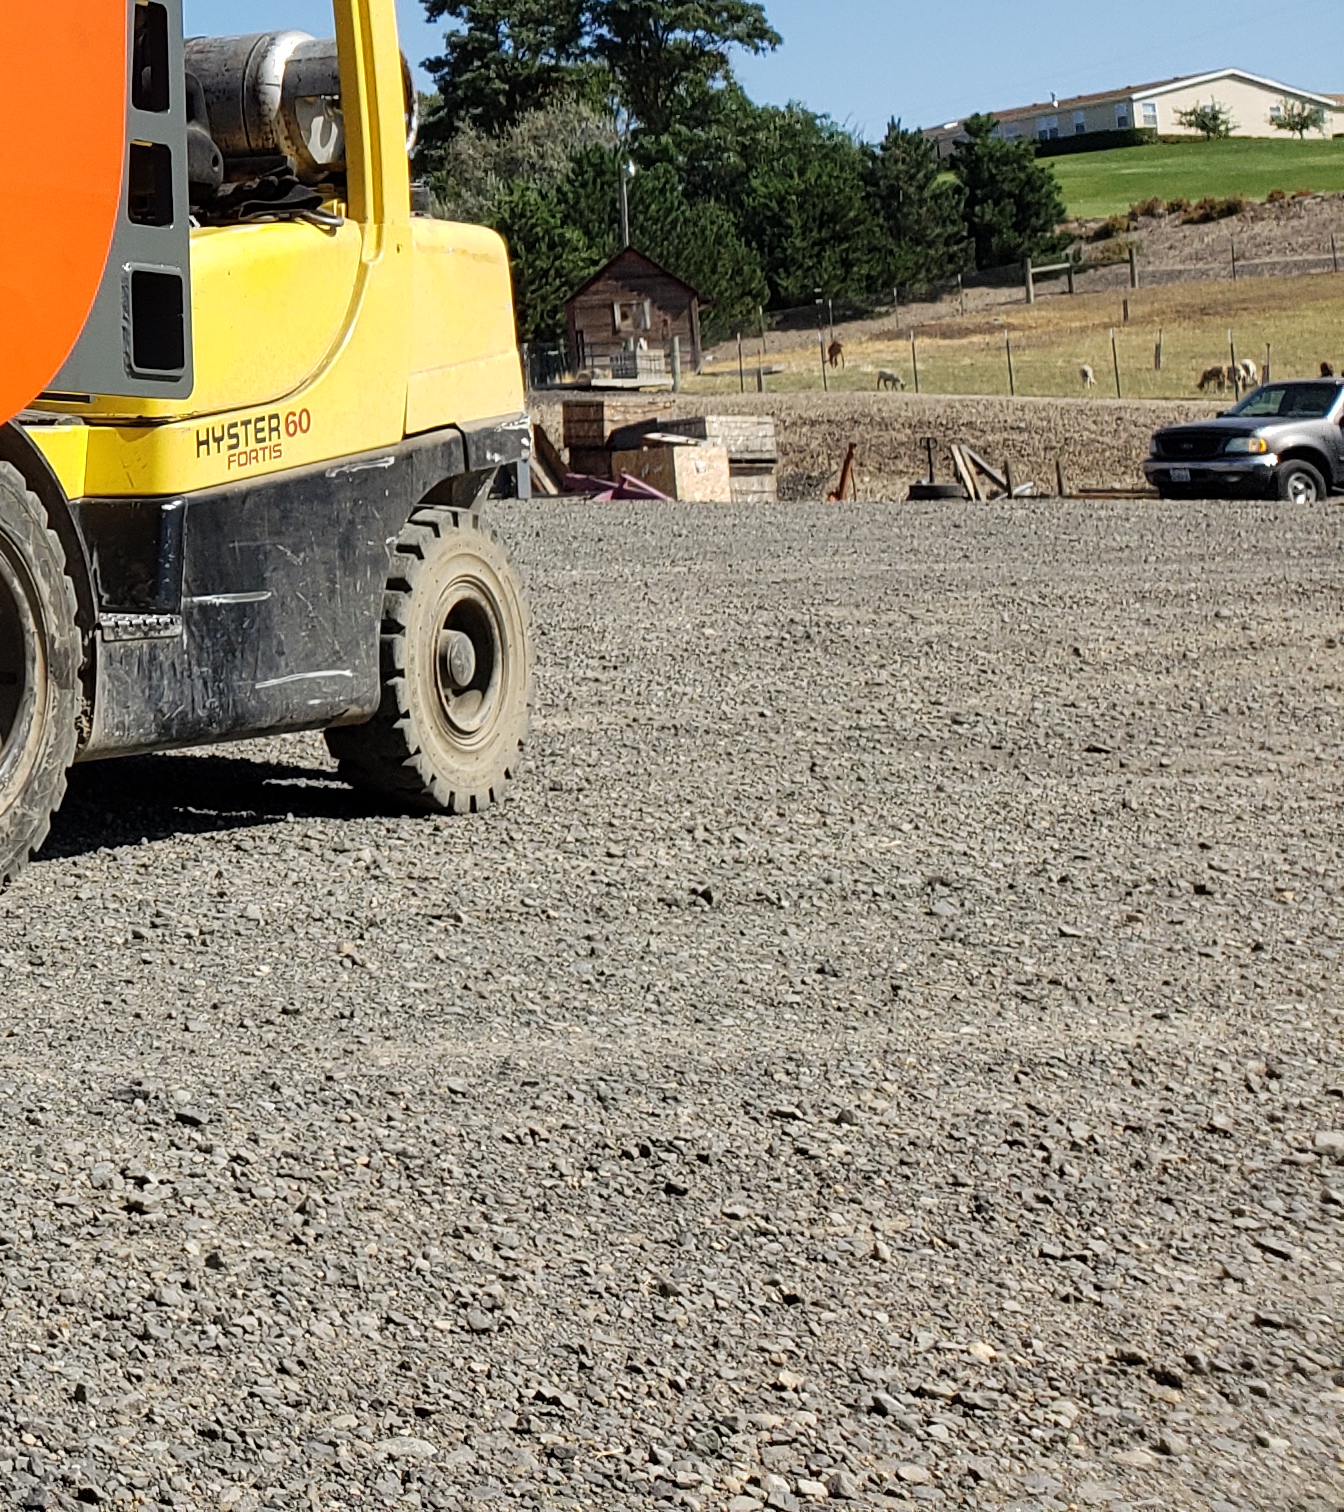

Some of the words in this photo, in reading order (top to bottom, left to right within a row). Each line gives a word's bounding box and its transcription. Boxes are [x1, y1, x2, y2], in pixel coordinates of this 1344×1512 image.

[196, 413, 281, 459] HYSTER
[284, 408, 311, 437] 60
[227, 443, 282, 470] FORTIS
